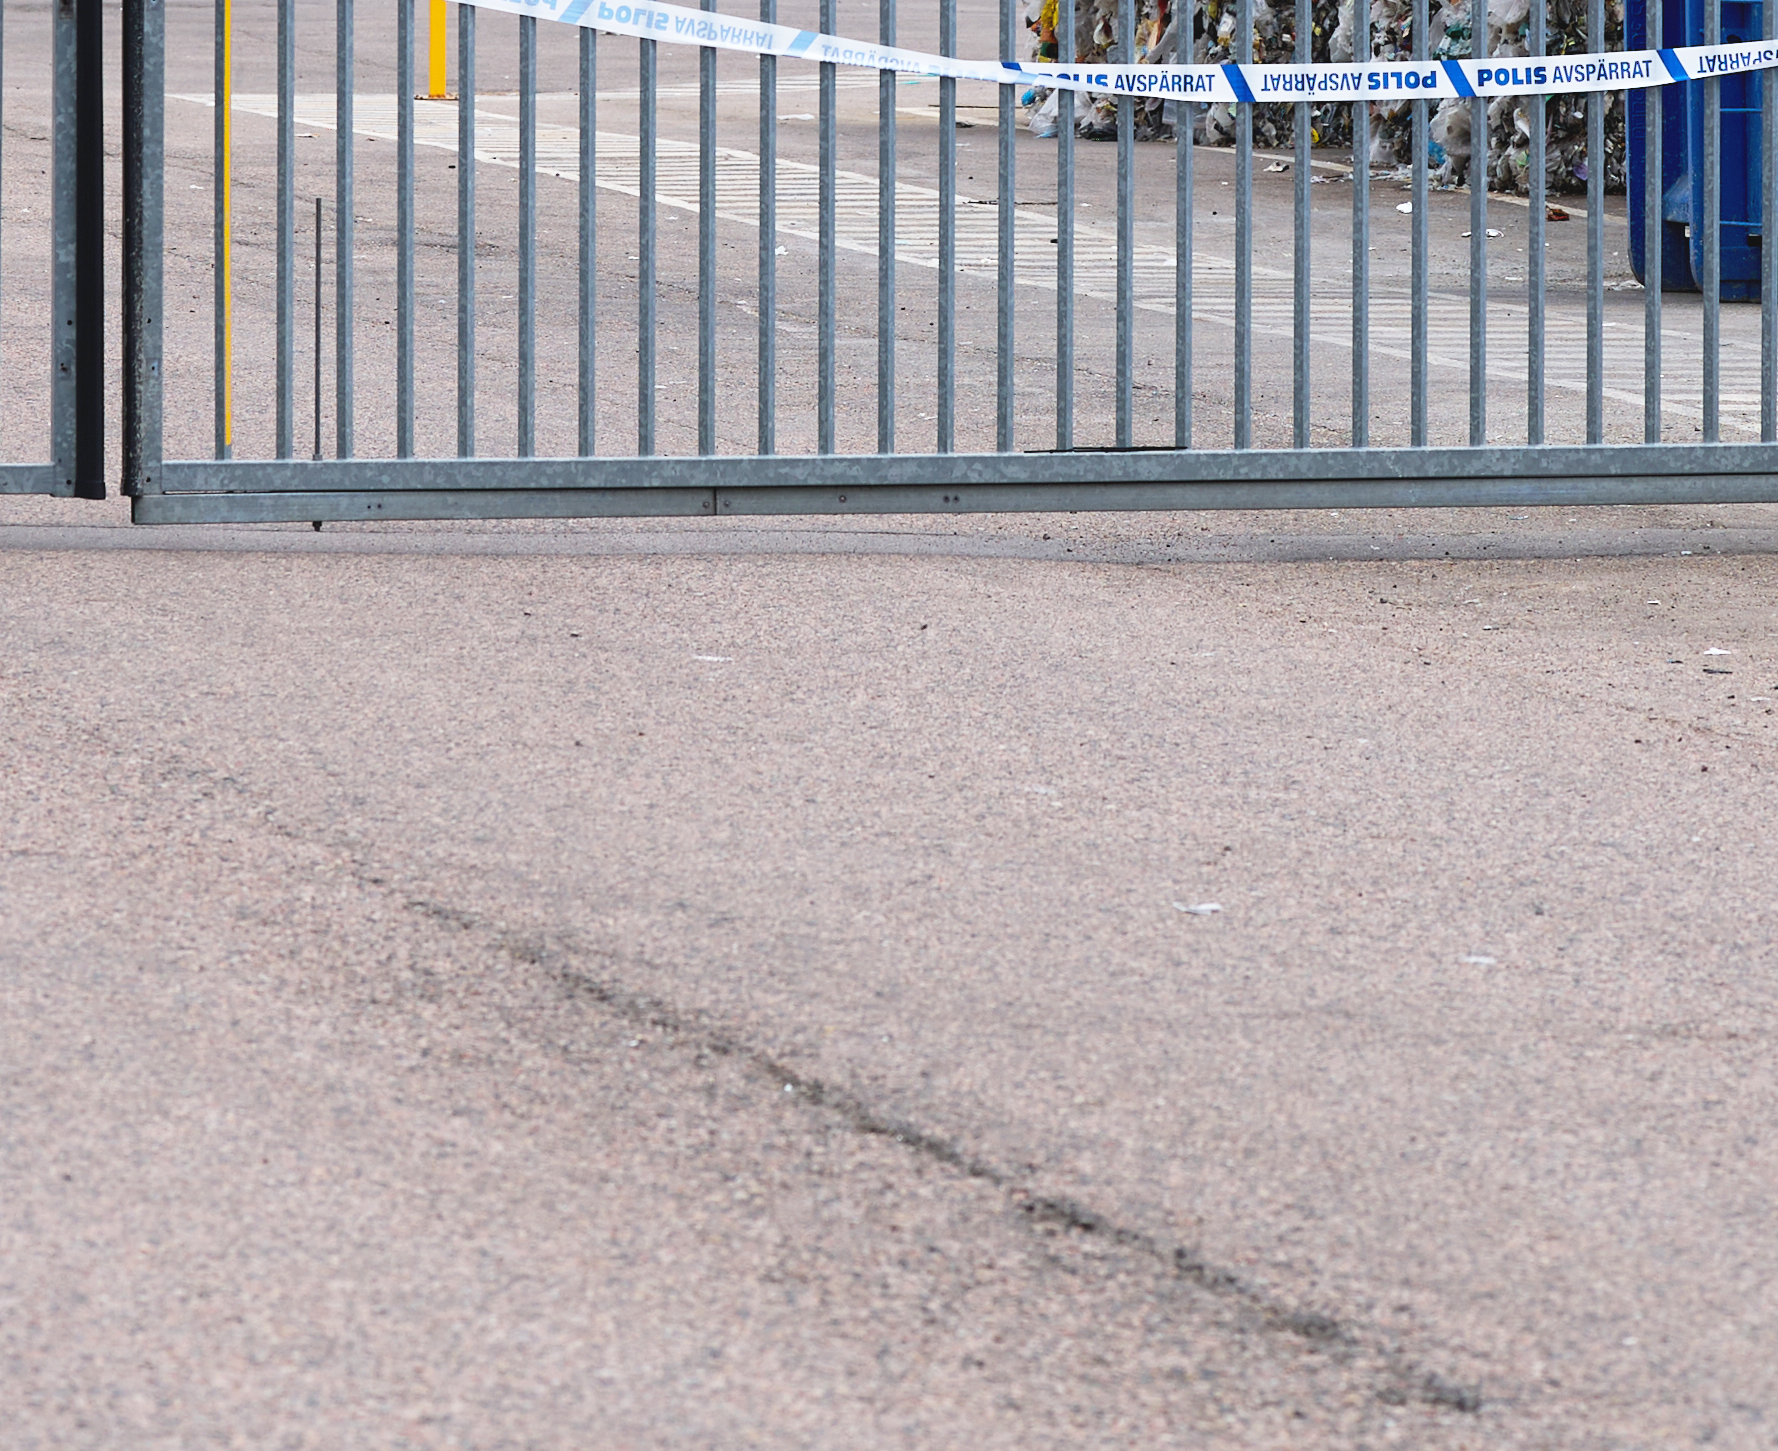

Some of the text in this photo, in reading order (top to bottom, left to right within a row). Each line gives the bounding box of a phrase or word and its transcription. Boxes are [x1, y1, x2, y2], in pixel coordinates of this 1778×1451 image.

[1115, 70, 1216, 92] AVSPÄRRAT
[1261, 69, 1437, 97] POLIS AVSPÄRRAT
[1477, 58, 1653, 88] POLIS AVSPÄRRAT
